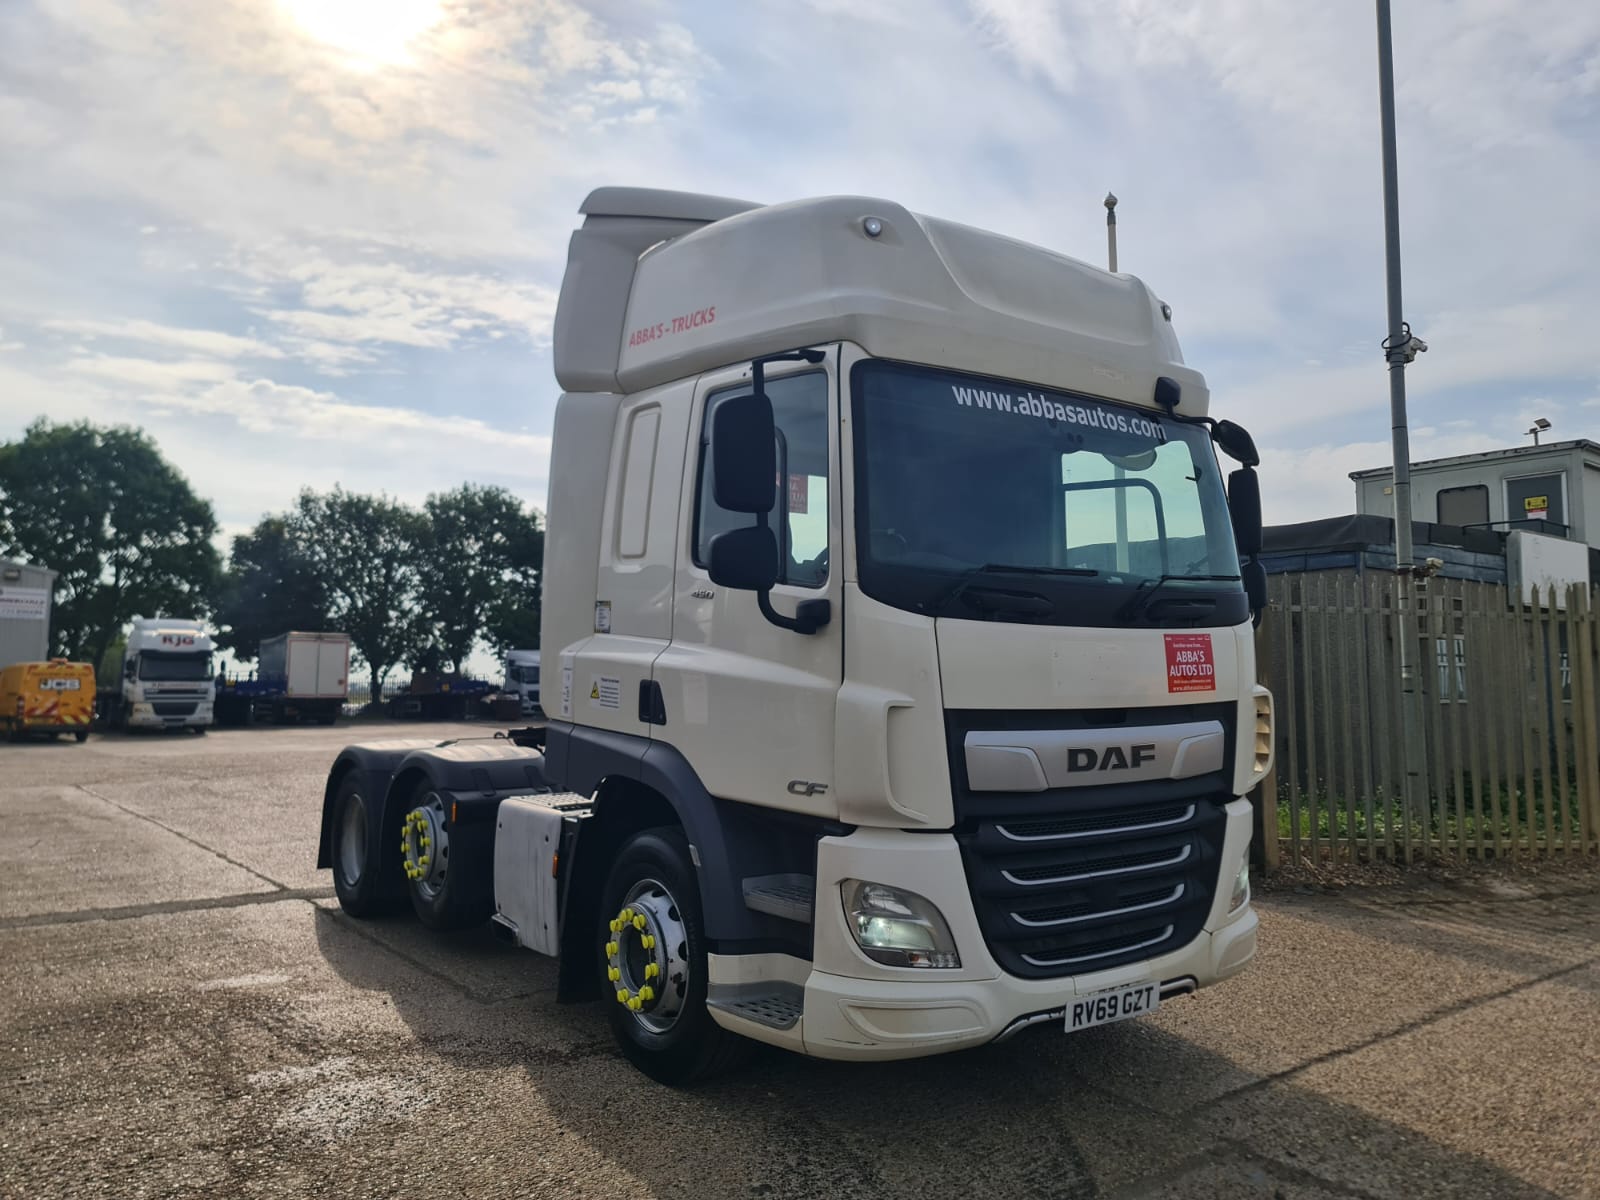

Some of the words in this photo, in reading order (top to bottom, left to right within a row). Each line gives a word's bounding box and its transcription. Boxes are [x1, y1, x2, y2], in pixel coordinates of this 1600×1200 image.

[629, 322, 664, 347] ABBA'S
[672, 305, 716, 335] TRUCKS
[951, 385, 1168, 440] www.abbasautos.com
[1169, 664, 1198, 677] AUTOS
[1198, 663, 1213, 676] LTD
[1175, 650, 1206, 663] ABBA'S
[1067, 743, 1156, 773] DAF
[787, 780, 829, 797] CF
[1072, 995, 1119, 1028] RV69
[1122, 985, 1154, 1015] GZT
